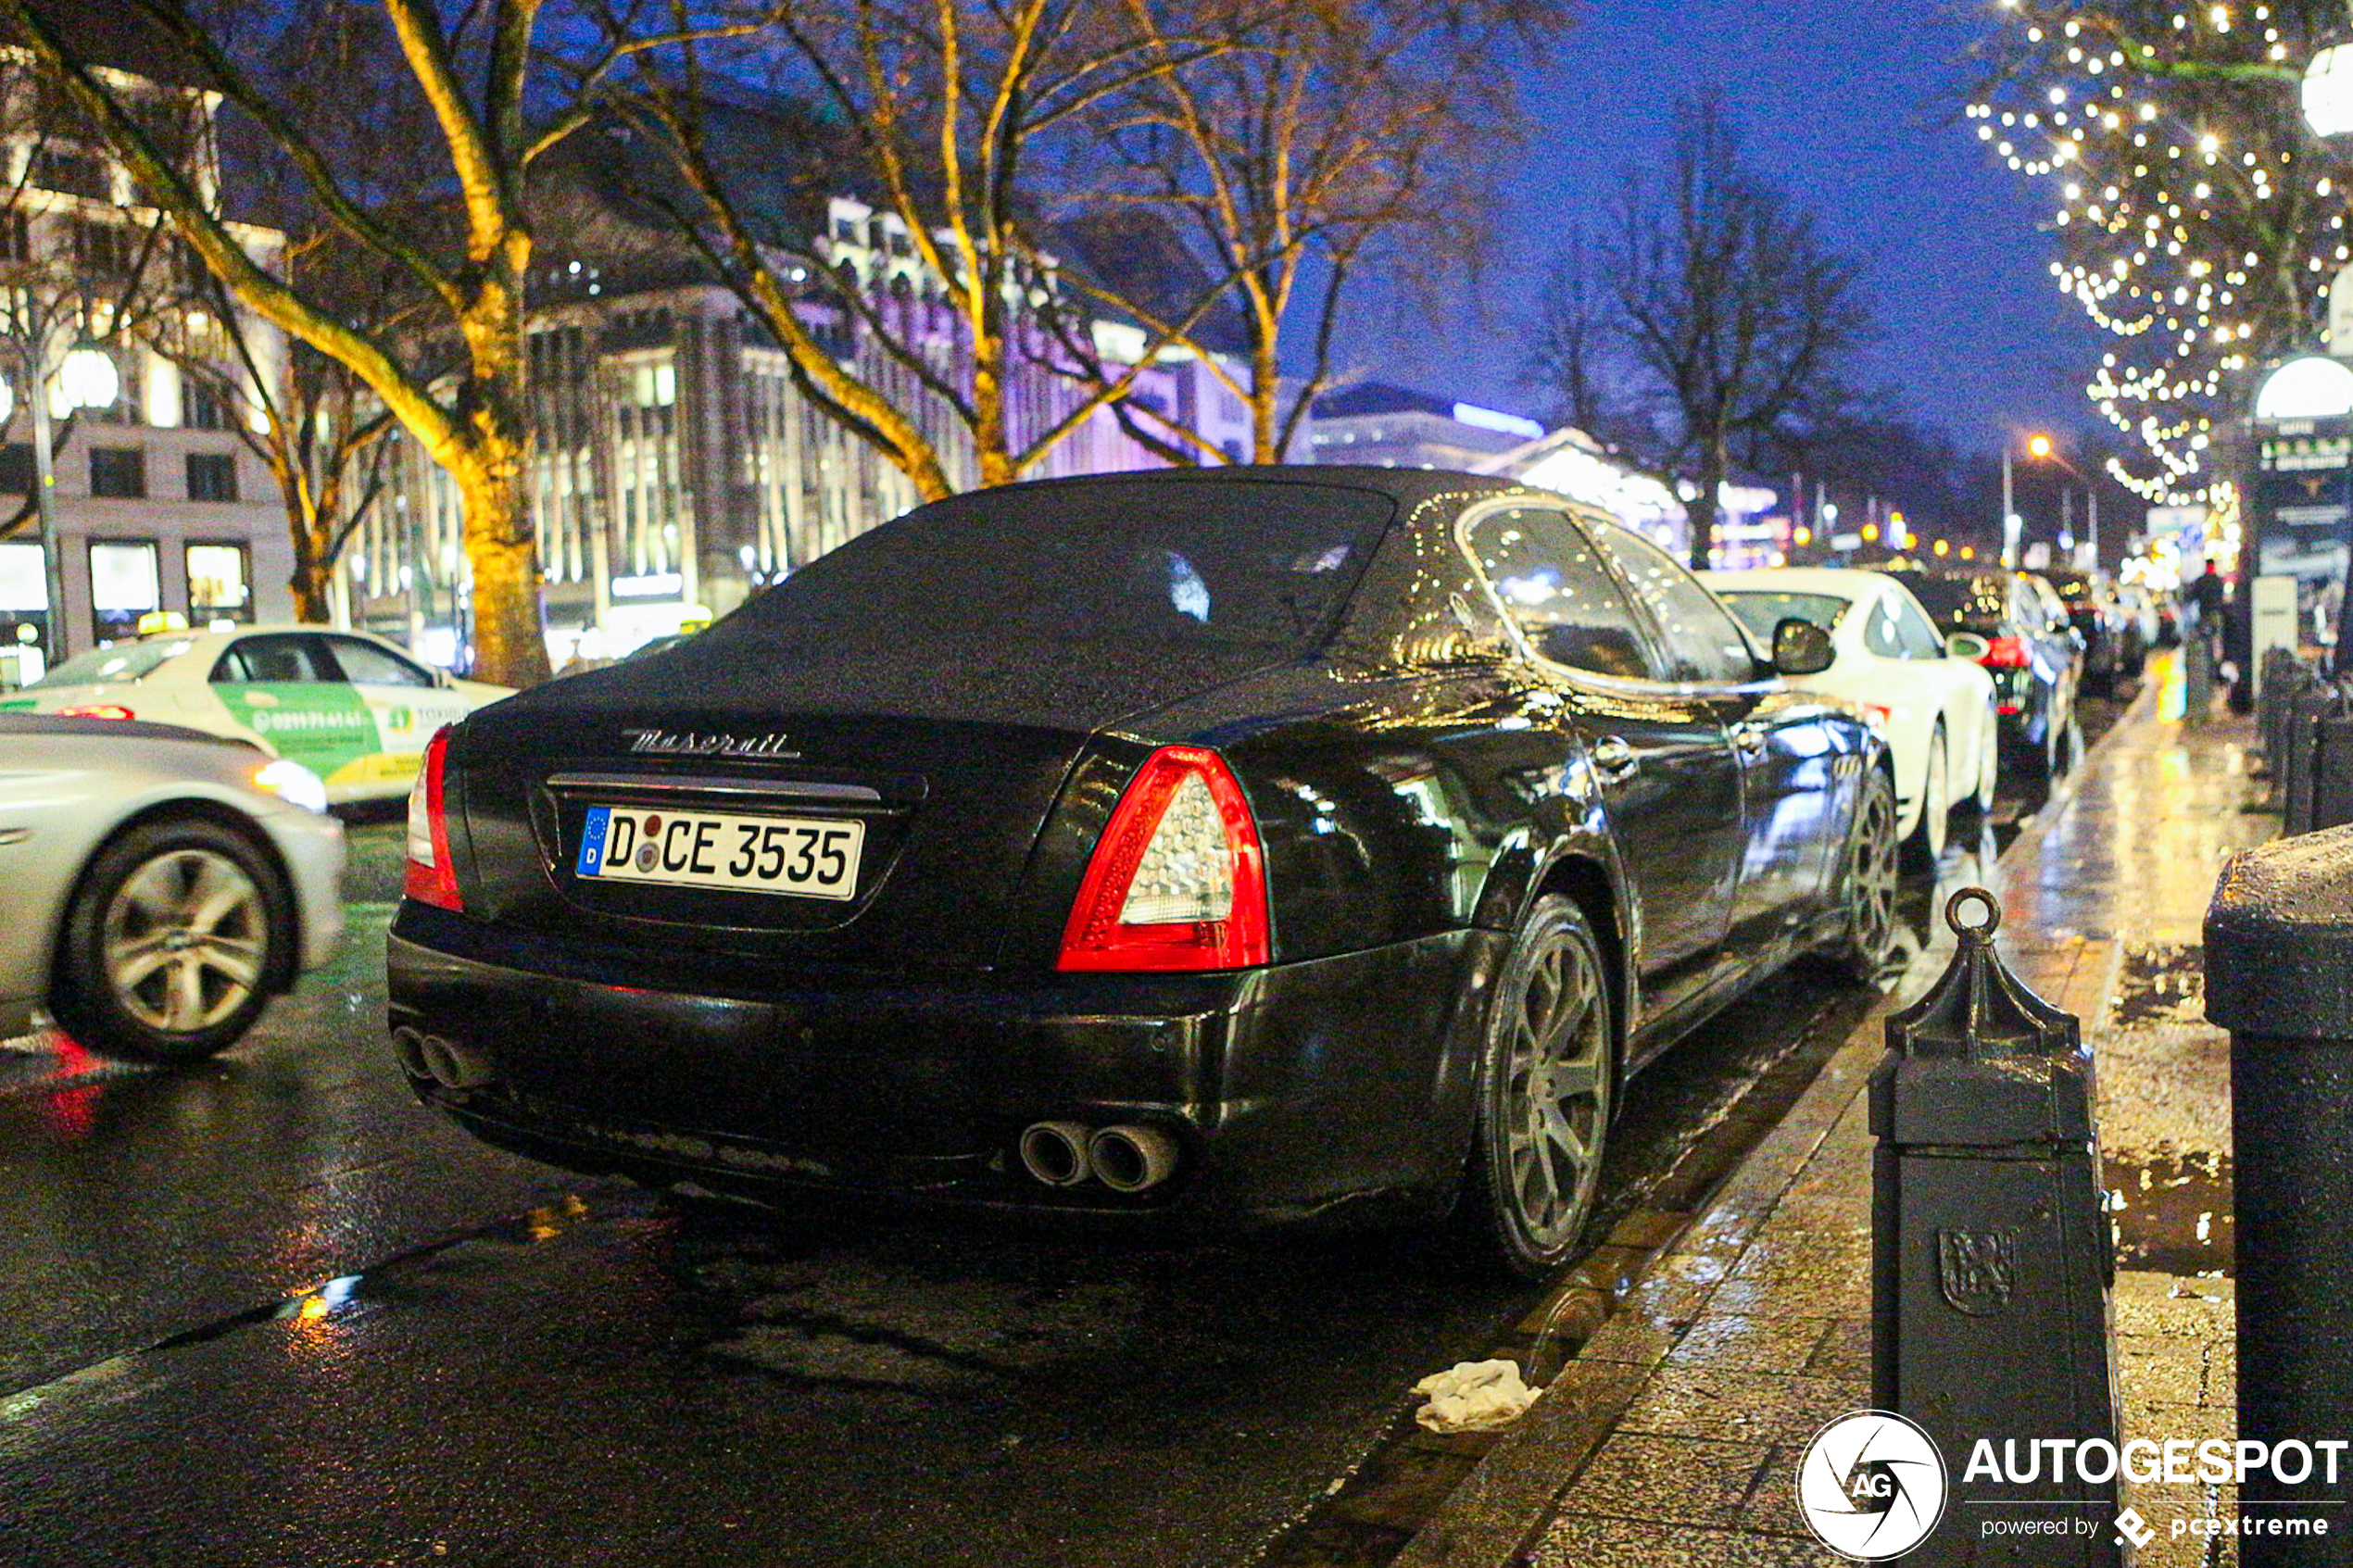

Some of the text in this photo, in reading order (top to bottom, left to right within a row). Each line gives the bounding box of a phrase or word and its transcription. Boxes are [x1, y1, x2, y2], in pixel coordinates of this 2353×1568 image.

[623, 729, 800, 758] Maserati
[606, 816, 851, 884] D CE 3535
